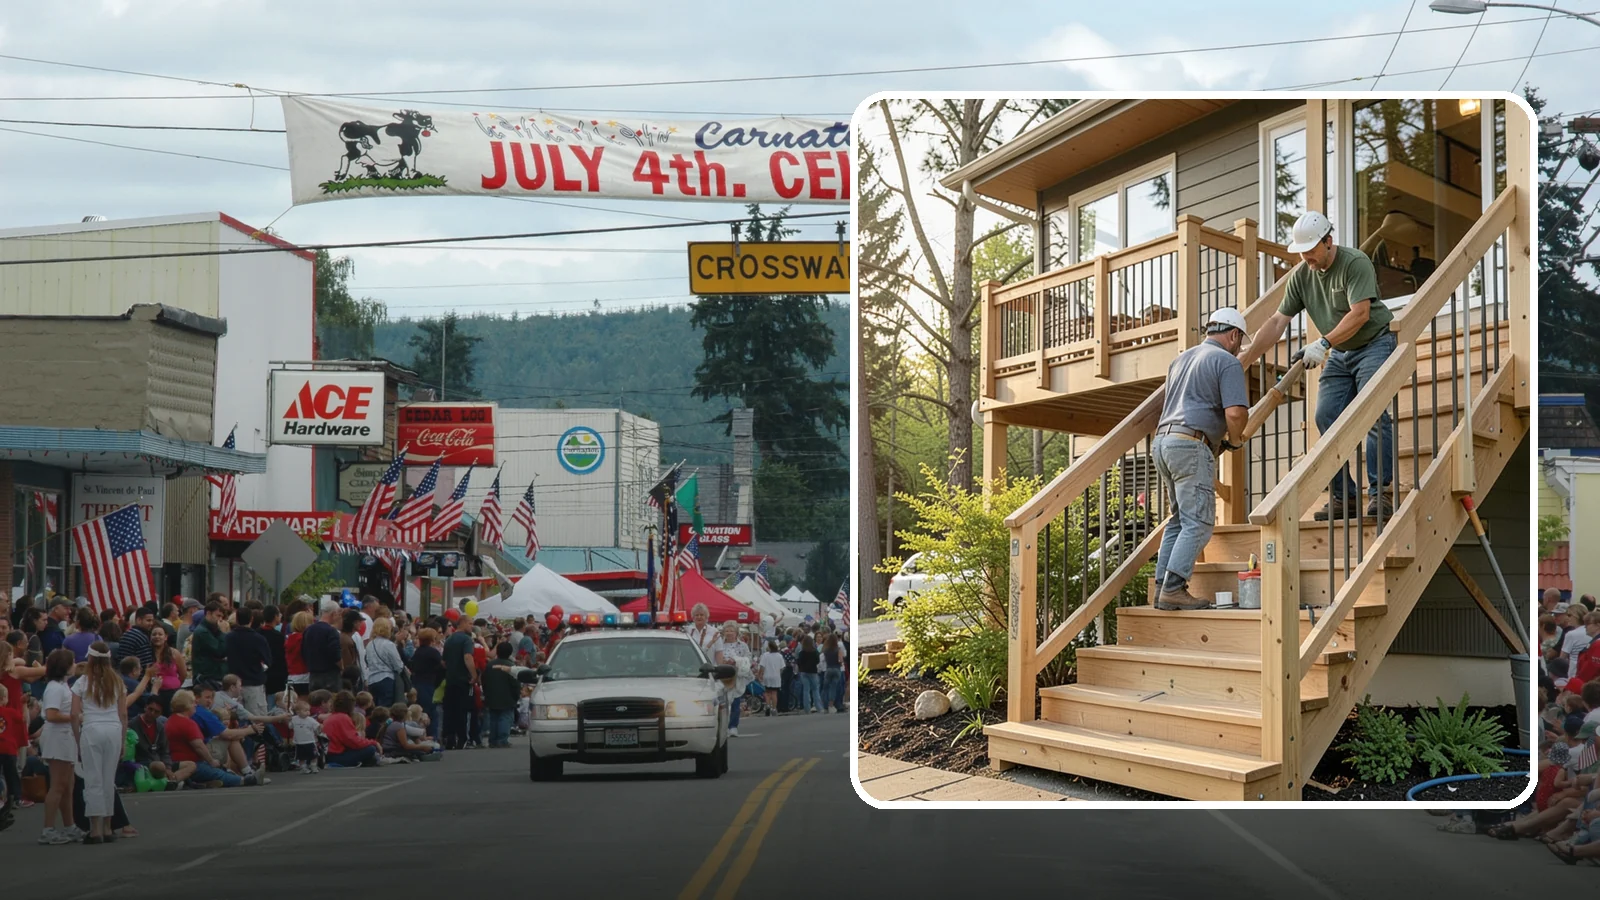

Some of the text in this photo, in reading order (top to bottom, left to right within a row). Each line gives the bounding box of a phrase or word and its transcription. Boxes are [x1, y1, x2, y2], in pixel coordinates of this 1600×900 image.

[695, 121, 850, 149] Carnat
[481, 141, 604, 192] JULY
[632, 150, 746, 197] 4th.
[697, 254, 850, 279] CROSSWA
[283, 380, 373, 420] ACE
[405, 409, 453, 422] CEDAR
[284, 421, 370, 436] Hardware
[95, 485, 124, 495] Vincent
[126, 486, 136, 494] de
[137, 486, 155, 495] Paul
[688, 526, 741, 535] CRNATION
[699, 535, 730, 543] GLASS
